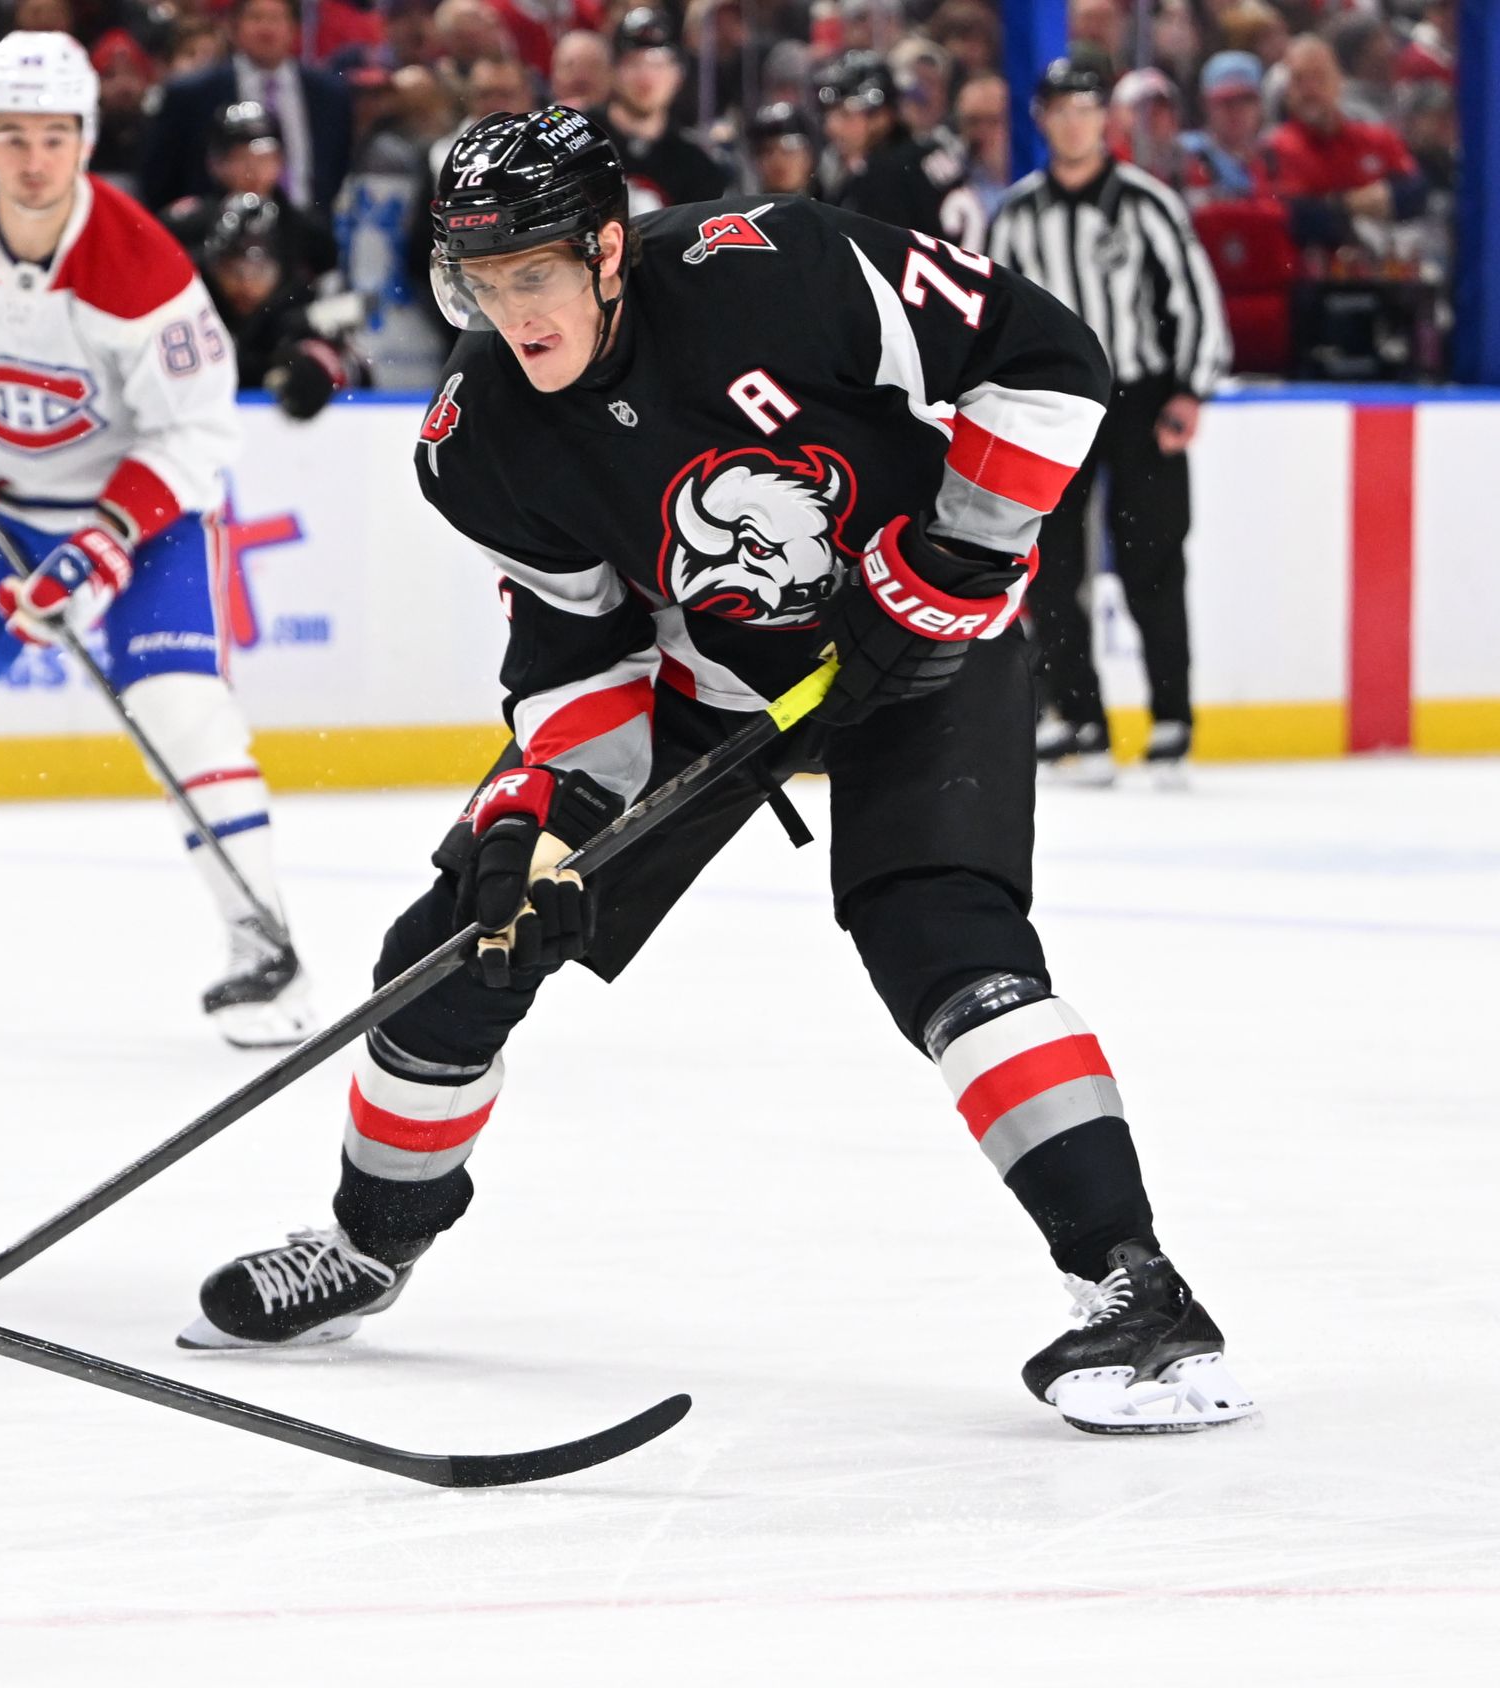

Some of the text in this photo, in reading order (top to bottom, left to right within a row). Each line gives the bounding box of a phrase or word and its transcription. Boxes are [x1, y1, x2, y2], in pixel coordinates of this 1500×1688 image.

[537, 113, 589, 148] Trusted
[450, 213, 498, 228] CCM
[158, 303, 228, 380] 85
[726, 368, 801, 437] A
